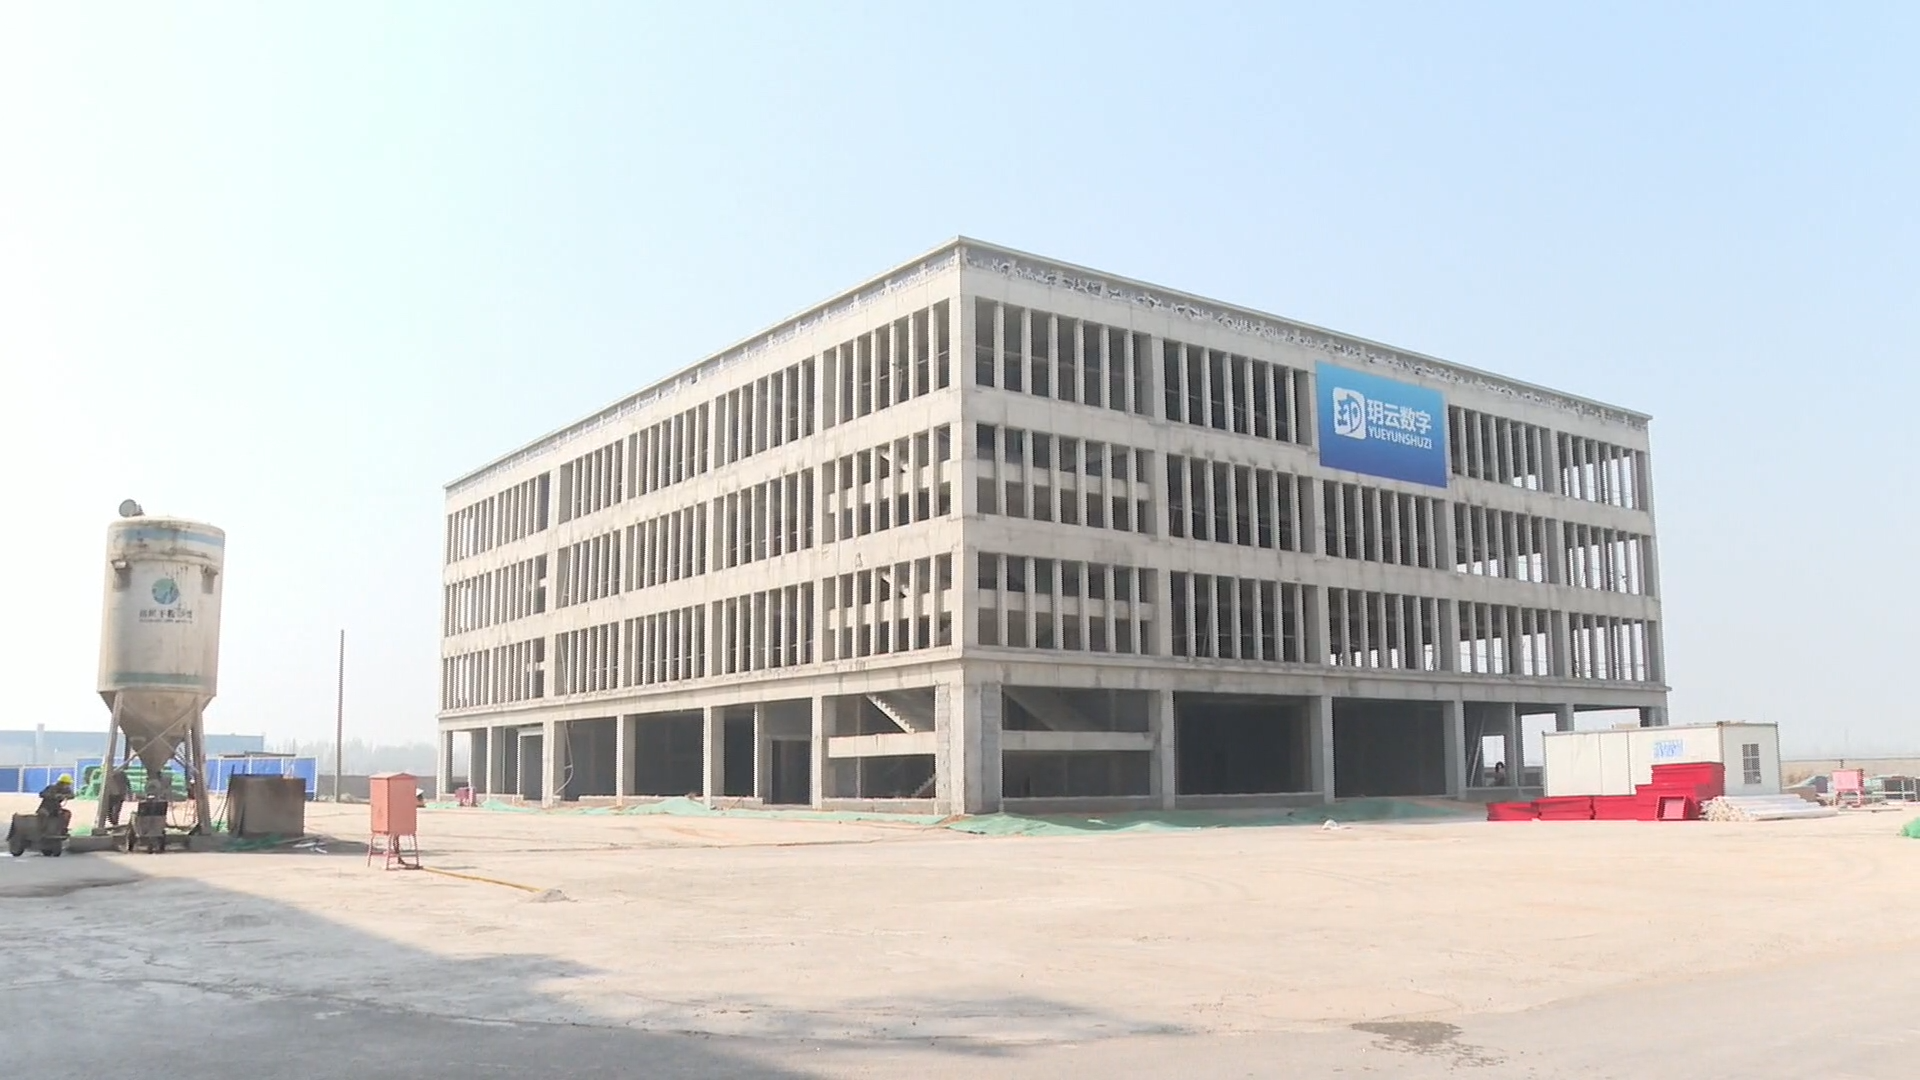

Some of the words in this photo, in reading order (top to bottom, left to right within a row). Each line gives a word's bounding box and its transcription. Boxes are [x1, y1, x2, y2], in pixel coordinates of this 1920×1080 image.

[1367, 399, 1432, 434] 玥云数字
[1368, 426, 1432, 449] YUEYUNSHUZI
